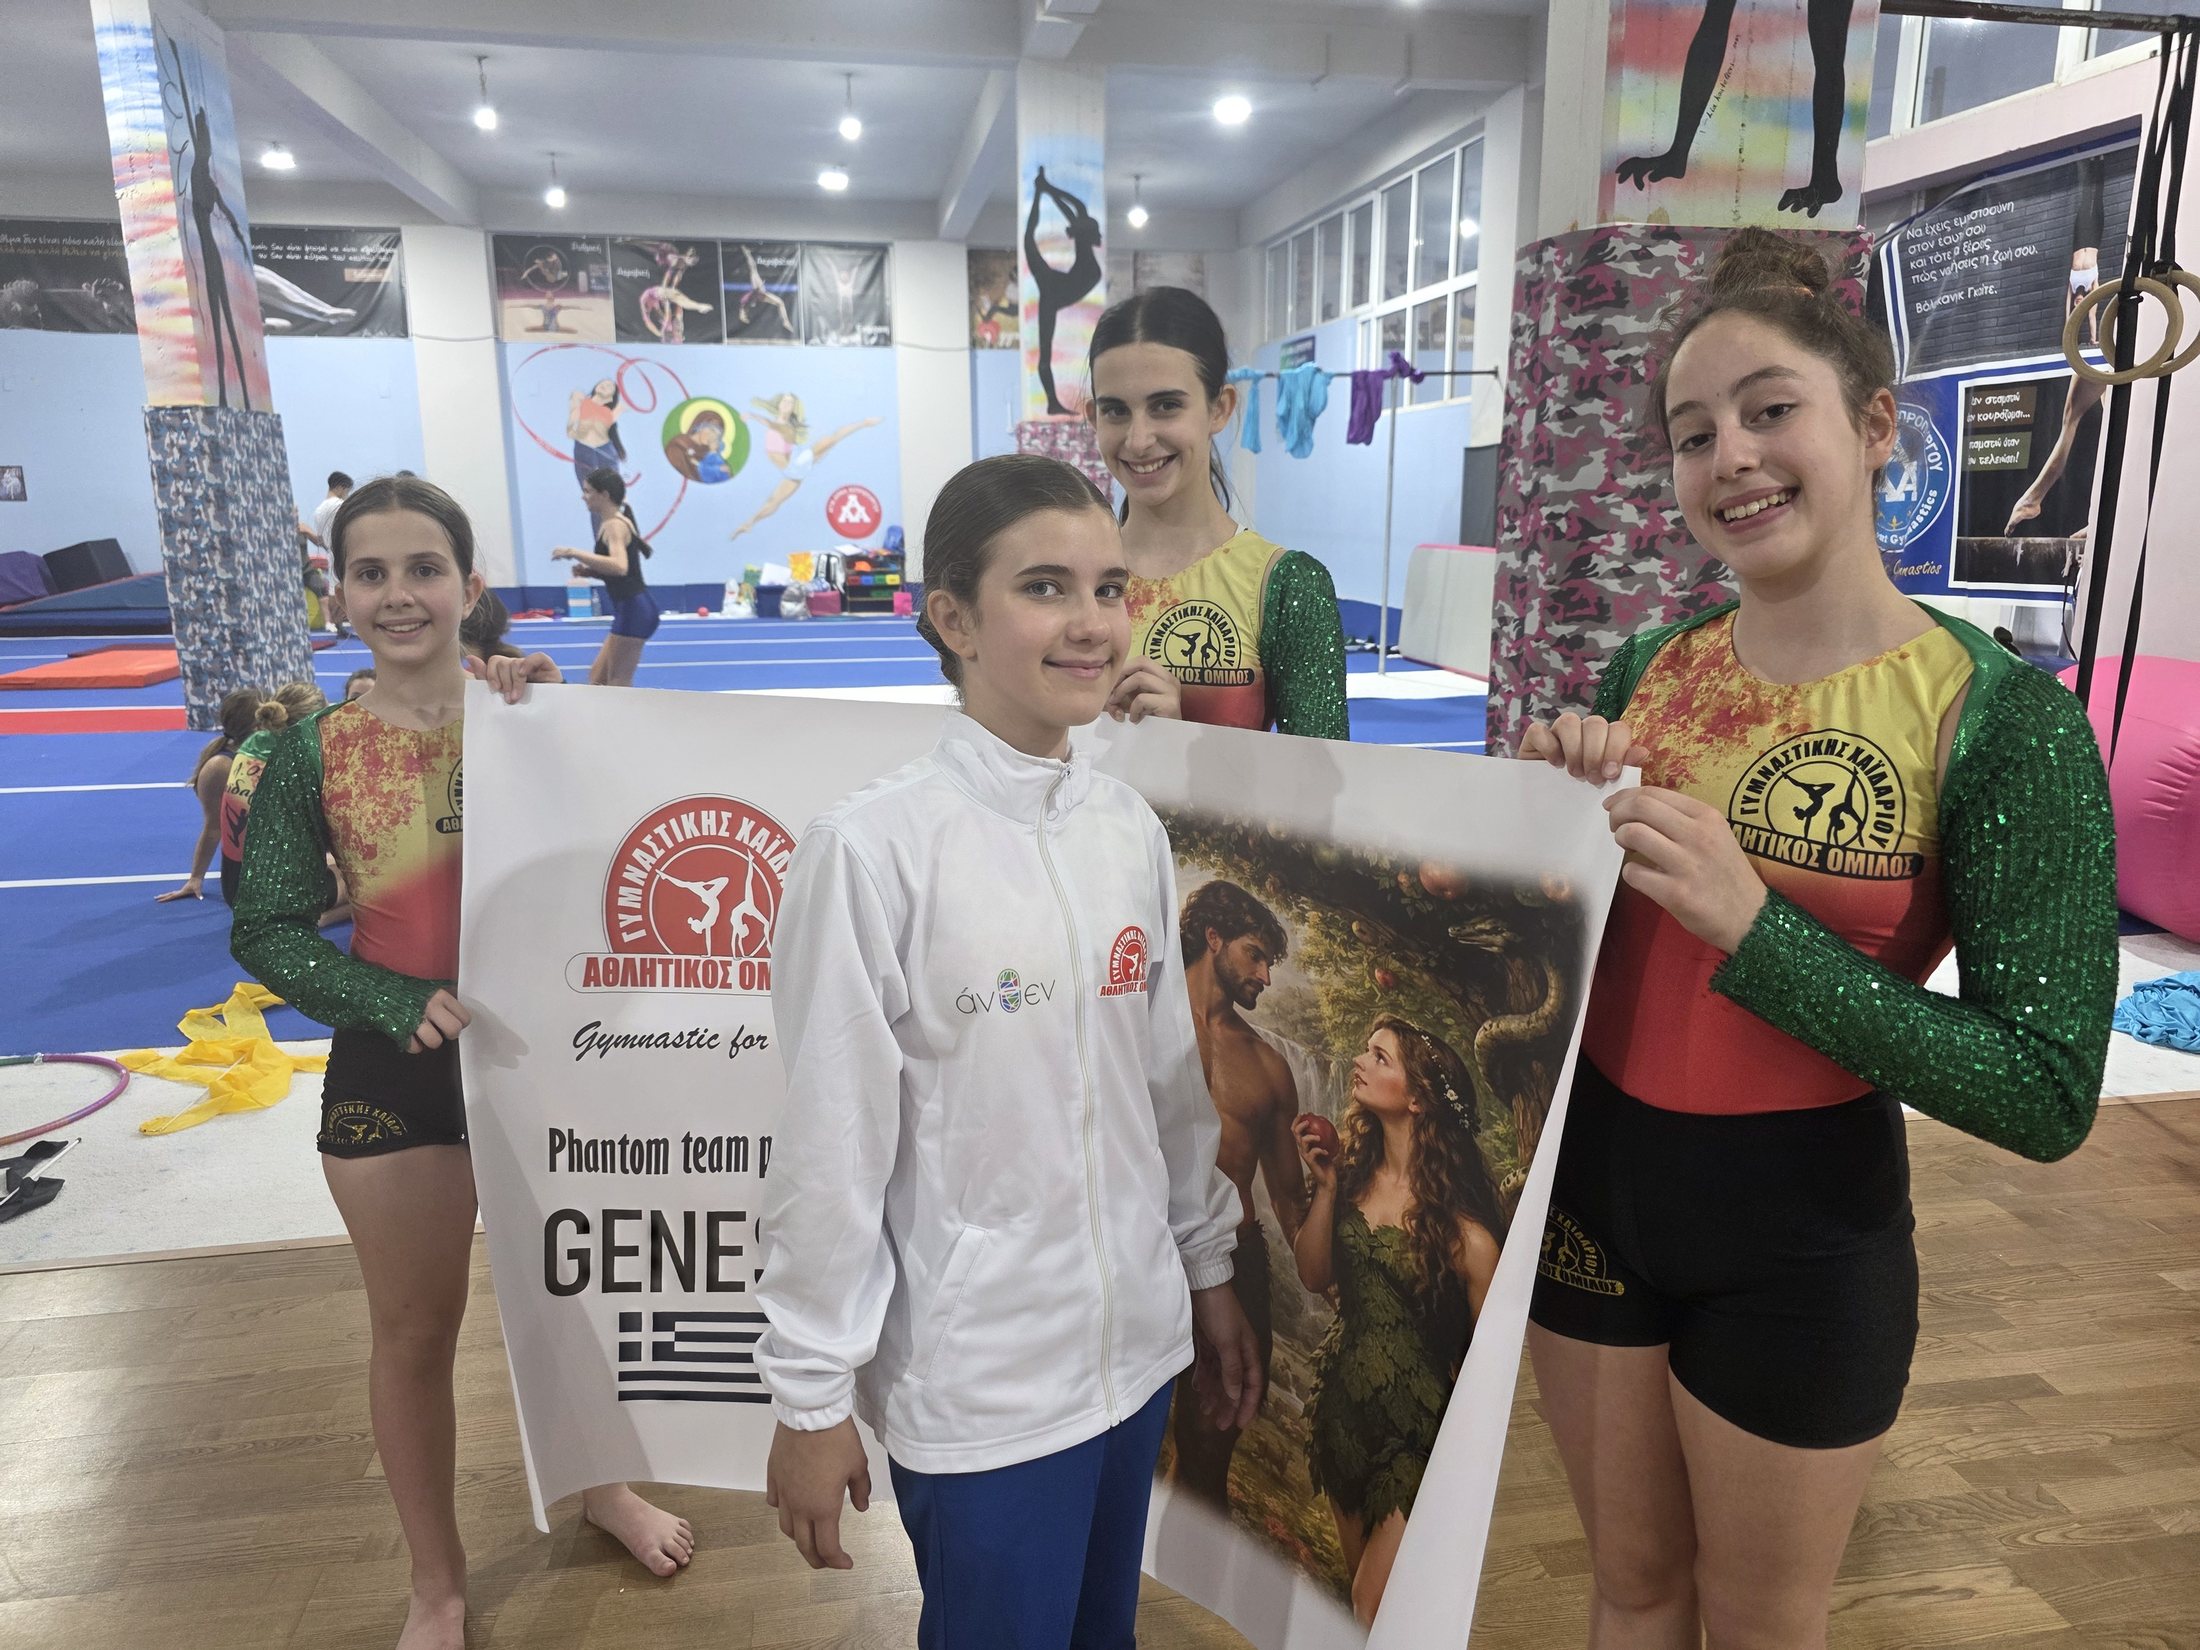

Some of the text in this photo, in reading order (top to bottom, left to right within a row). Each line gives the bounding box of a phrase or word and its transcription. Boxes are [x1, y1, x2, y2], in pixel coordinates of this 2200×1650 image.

[1906, 229, 1923, 240] Να
[1925, 220, 1951, 236] έχεις
[1908, 240, 1936, 255] στον
[1965, 224, 1987, 237] σου
[1910, 258, 1926, 270] και
[1928, 251, 1952, 264] τότε
[1911, 270, 1938, 285] πώς
[1992, 247, 2013, 265] ζωή
[2014, 245, 2038, 258] σου.
[1204, 669, 1249, 684] ΟΜΙΛΟΣ
[1741, 738, 1896, 849] ΓΥΜΝΑΣΤΙΚΗΣ ΧΑΪΔΑΡΙΟΥ
[1733, 826, 1913, 877] ΛΗΤΙΚΟΣ ΟΜΙΛΟΣ
[617, 810, 733, 944] ΓΥΜΝΑΣΤΙΚΗΣ
[583, 957, 732, 990] ΑΘΛΗΤΙΚΟΣ
[572, 1020, 770, 1062] Gymnastic for
[548, 1127, 670, 1175] Phantom
[681, 1131, 749, 1175] team
